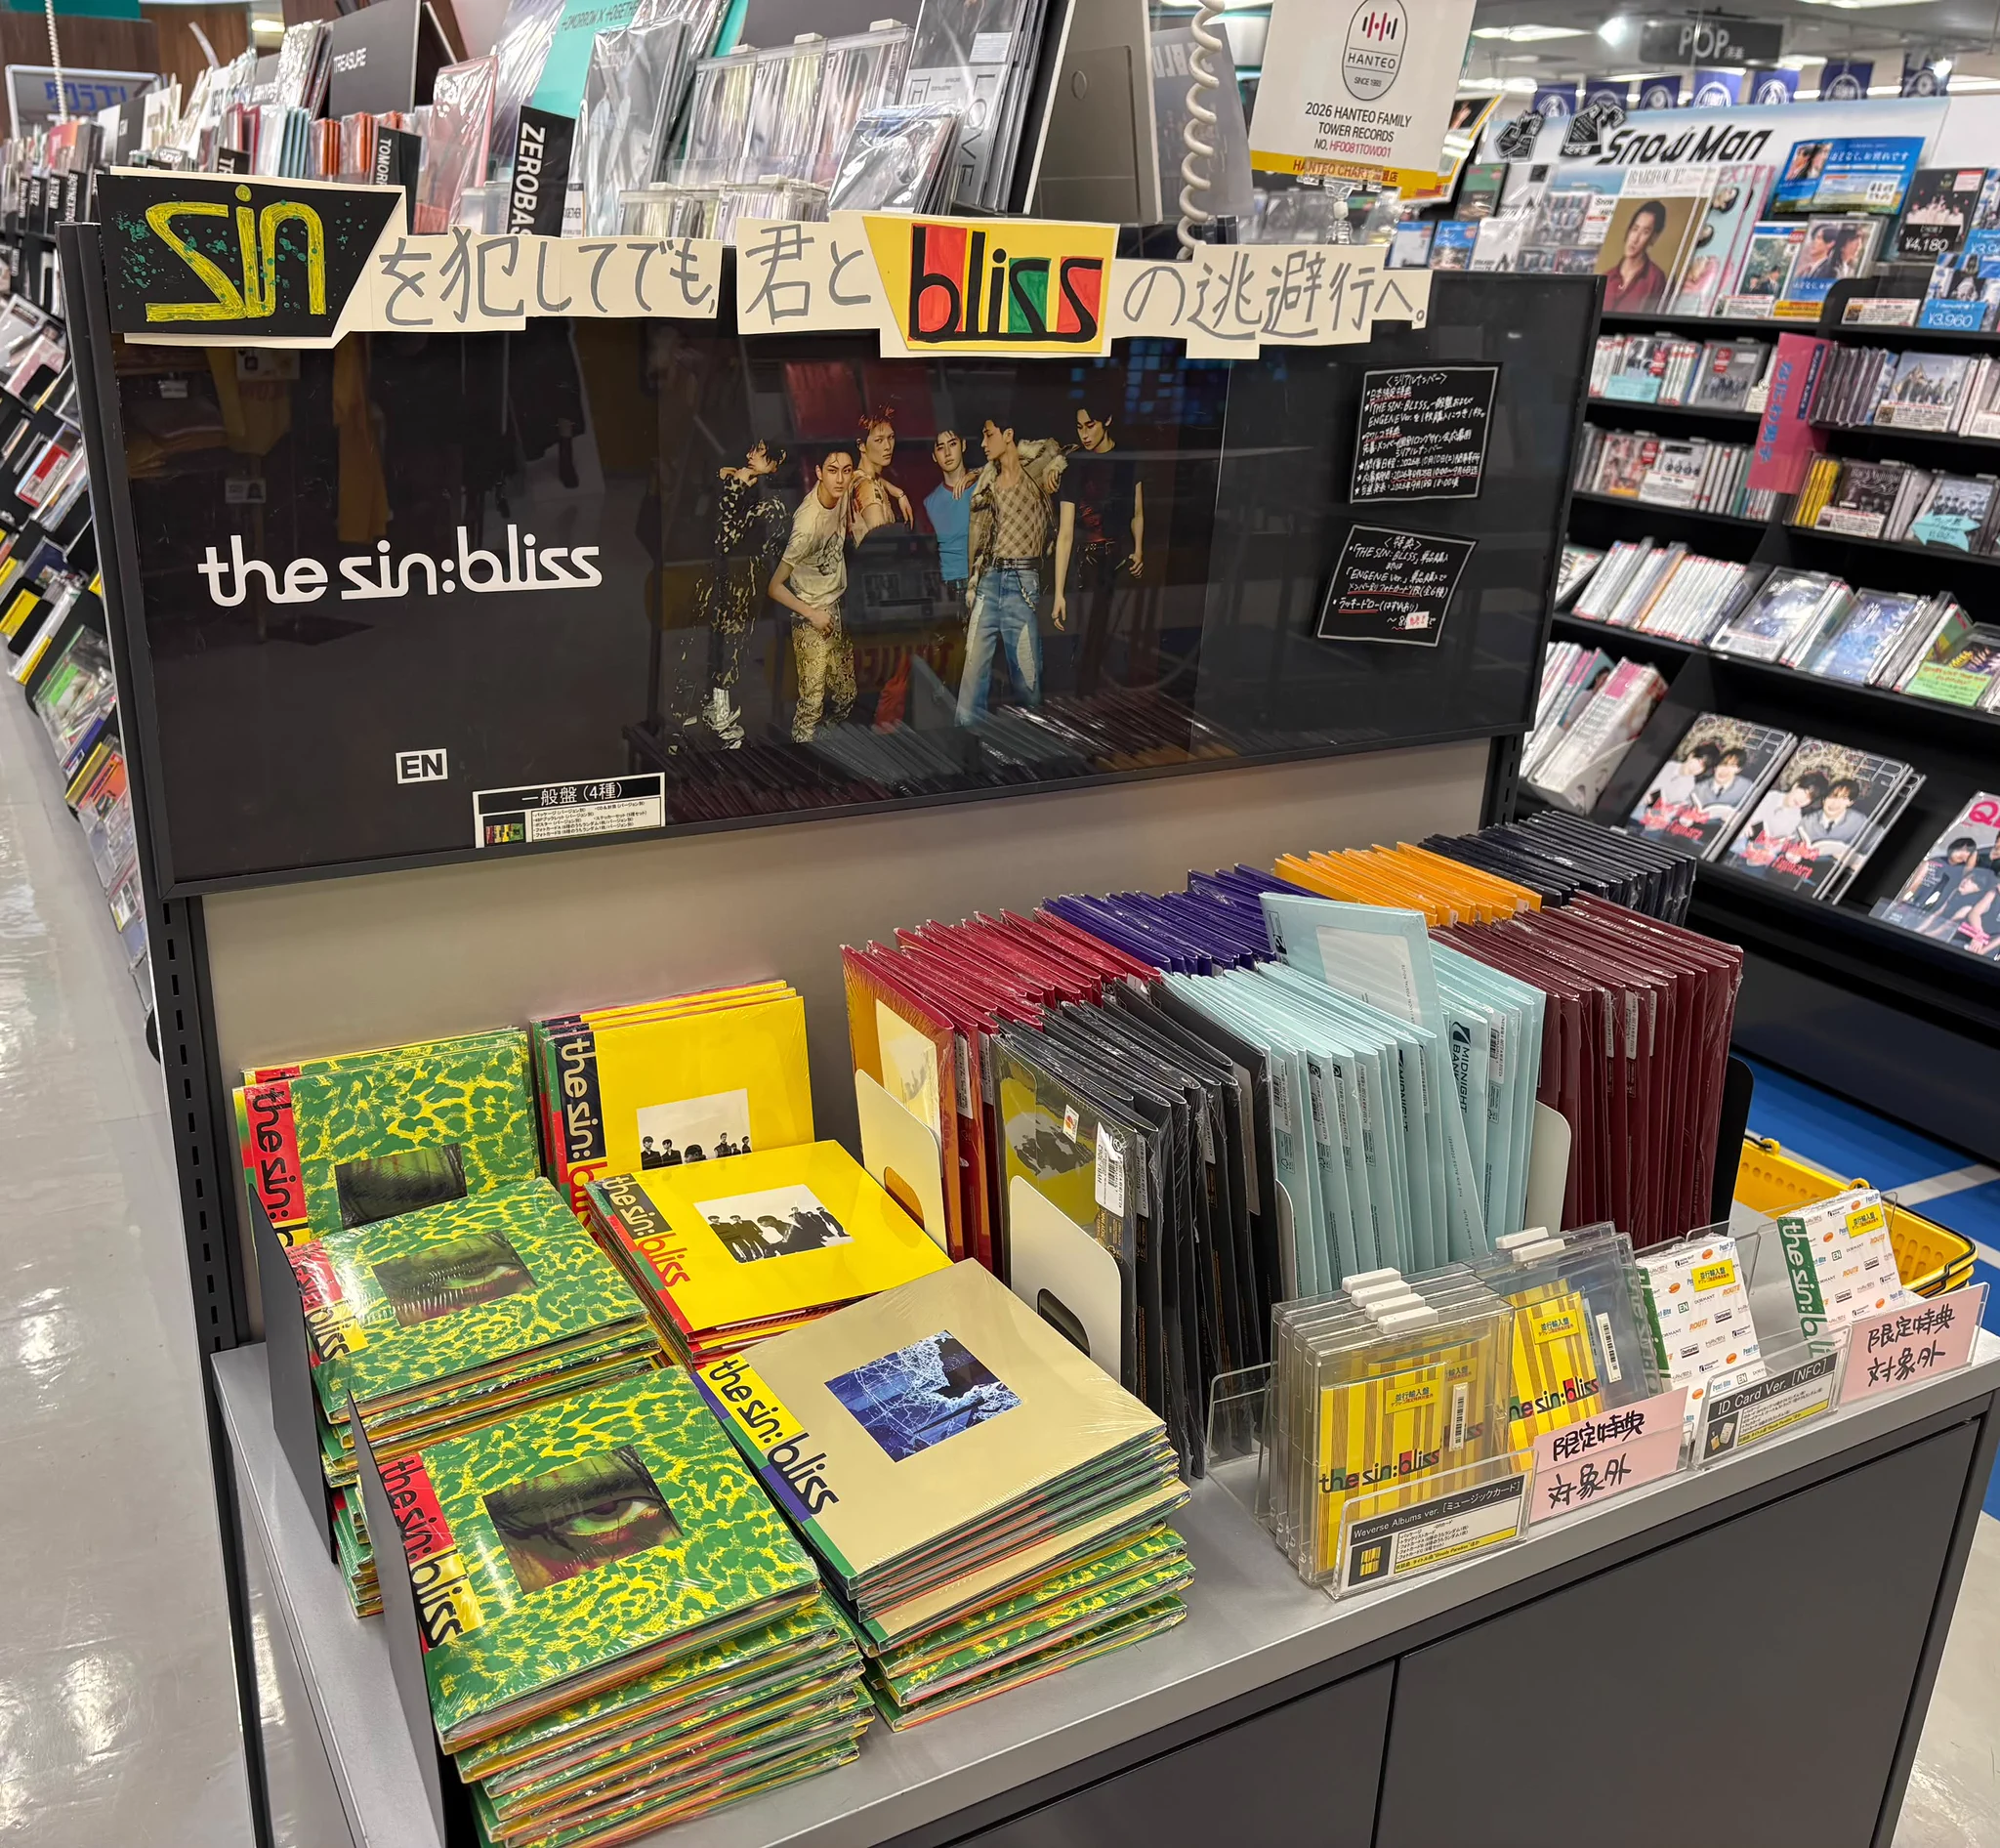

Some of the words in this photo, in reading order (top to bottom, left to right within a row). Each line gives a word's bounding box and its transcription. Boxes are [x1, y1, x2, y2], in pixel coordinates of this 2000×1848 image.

[333, 47, 367, 74] TREASURE
[1347, 52, 1396, 70] HANTEO
[1678, 25, 1729, 59] POP
[1305, 102, 1333, 118] 2026
[1334, 105, 1376, 124] HANTEO
[1376, 111, 1412, 128] FAMILY
[1318, 122, 1352, 138] TOWER
[1352, 126, 1395, 143] RECORDS
[1313, 138, 1328, 151] NO.
[1596, 126, 1695, 167] Snow
[1688, 125, 1773, 164] Man
[1293, 159, 1336, 176] HANTEO
[146, 184, 327, 323] sin
[744, 224, 872, 326] 君と
[908, 223, 1104, 344] bliss
[1124, 249, 1427, 341] の逃避行へ。
[197, 535, 328, 607] the
[339, 525, 603, 600] sin:bliss
[399, 752, 445, 781] EN
[561, 1038, 597, 1098] the
[1459, 1046, 1472, 1113] MIDNIGHT
[252, 1088, 292, 1154] the
[603, 1175, 636, 1206] the
[1782, 1222, 1807, 1266] the
[1867, 1303, 1956, 1354] 限定特典
[708, 1360, 750, 1404] the
[1867, 1340, 1946, 1388] 対象外
[1510, 1397, 1534, 1421] he
[1535, 1376, 1600, 1414] sin:bliss
[1718, 1401, 1730, 1415] ID
[1734, 1389, 1762, 1407] Card
[1766, 1380, 1786, 1397] Ver.
[1791, 1359, 1827, 1386] [NFC]
[1553, 1410, 1646, 1462] 限定特典
[380, 1459, 422, 1510] the
[1319, 1473, 1359, 1493] the
[1361, 1449, 1440, 1487] sin:bliss
[1548, 1453, 1632, 1509] 対象外
[1354, 1523, 1390, 1539] Weverse
[1392, 1513, 1422, 1528] Albums
[1424, 1507, 1439, 1518] ver.
